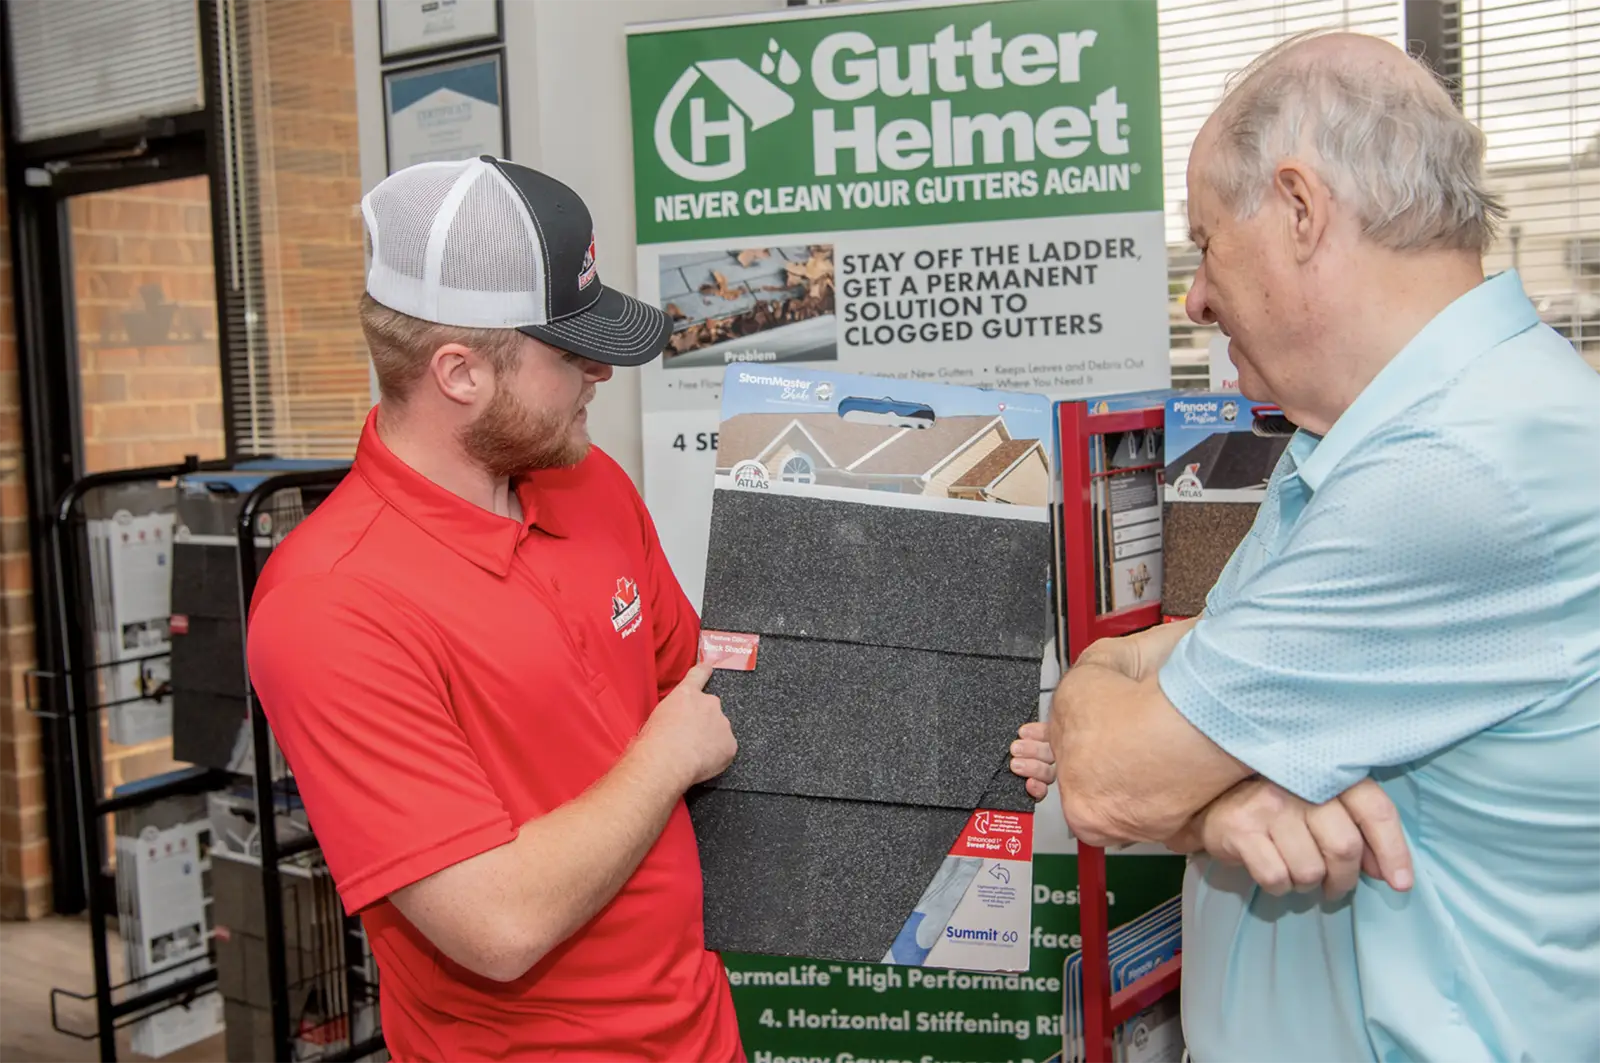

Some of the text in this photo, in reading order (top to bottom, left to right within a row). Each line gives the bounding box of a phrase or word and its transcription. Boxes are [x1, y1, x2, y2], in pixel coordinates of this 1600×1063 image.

[811, 20, 1098, 101] Gutter
[812, 85, 1130, 176] Helmet
[655, 163, 1131, 222] NEVER CLEAN YOUR GUTTERS AGAIN
[843, 237, 1142, 275] STAY OFF THE LADDER,
[843, 264, 1098, 298] GET A PERMANENT
[844, 292, 1028, 323] SOLUTION TO
[844, 312, 1104, 346] CLOGGED GUTTERS
[724, 349, 776, 363] Problem
[910, 368, 936, 379] New
[937, 367, 974, 378] Gutters
[994, 357, 1144, 377] Keeps Leaves and Debris Out
[739, 372, 812, 389] StormMaster
[997, 377, 1031, 388] Where
[1033, 377, 1052, 388] You
[1054, 375, 1084, 387] Need
[1173, 400, 1218, 413] Pinnacle
[672, 432, 687, 452] 4
[737, 478, 769, 490] ATLAS
[1180, 489, 1203, 498] ATLAS
[724, 644, 754, 655] Shadow
[966, 841, 985, 849] Sweet
[986, 843, 1001, 851] Spot
[967, 835, 995, 844] Enhanced
[1033, 884, 1116, 906] Desin
[946, 926, 1019, 943] Summit 60
[725, 965, 1060, 993] ermaLife™ High Performance
[759, 1008, 783, 1029] 4.
[788, 1008, 910, 1031] Horizontal
[916, 1011, 1031, 1041] Stiffening
